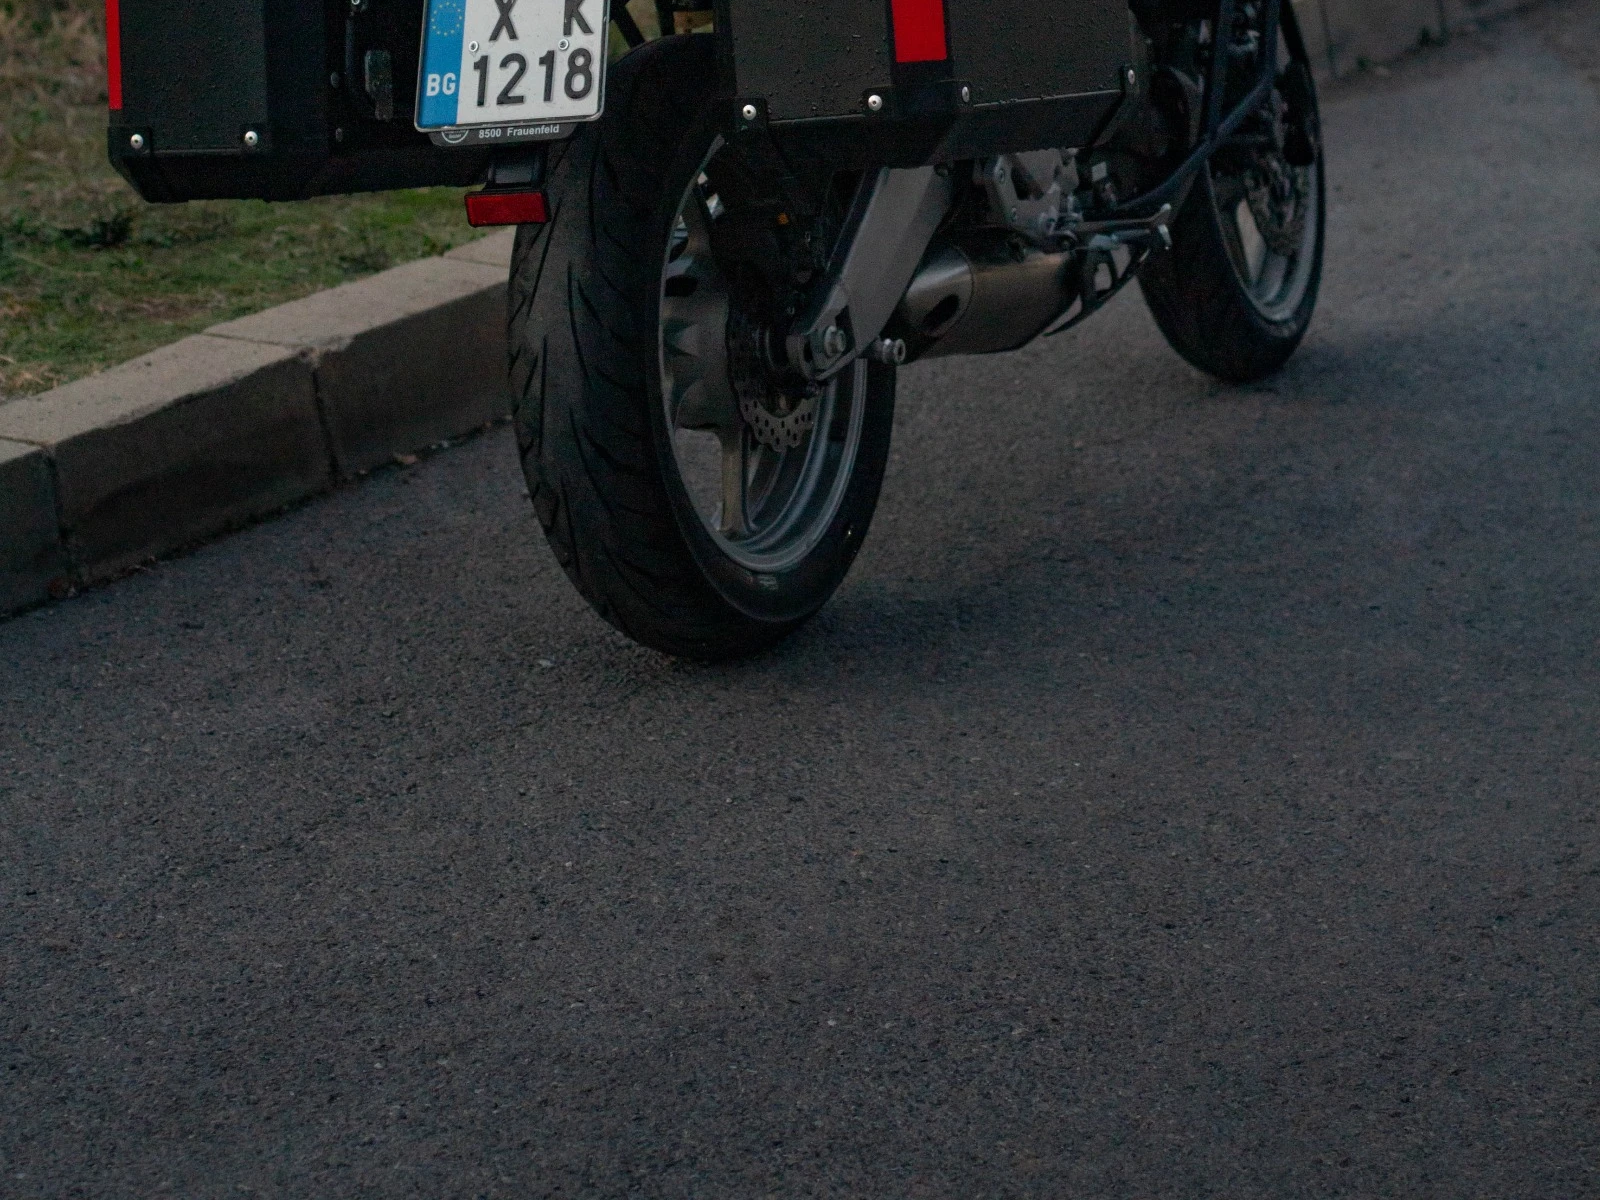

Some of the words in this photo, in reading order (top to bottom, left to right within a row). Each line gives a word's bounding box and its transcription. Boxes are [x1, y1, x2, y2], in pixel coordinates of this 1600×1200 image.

[426, 72, 456, 97] BG
[473, 47, 593, 107] 1218
[478, 128, 502, 139] 8500
[506, 123, 560, 137] Frauenfeld
